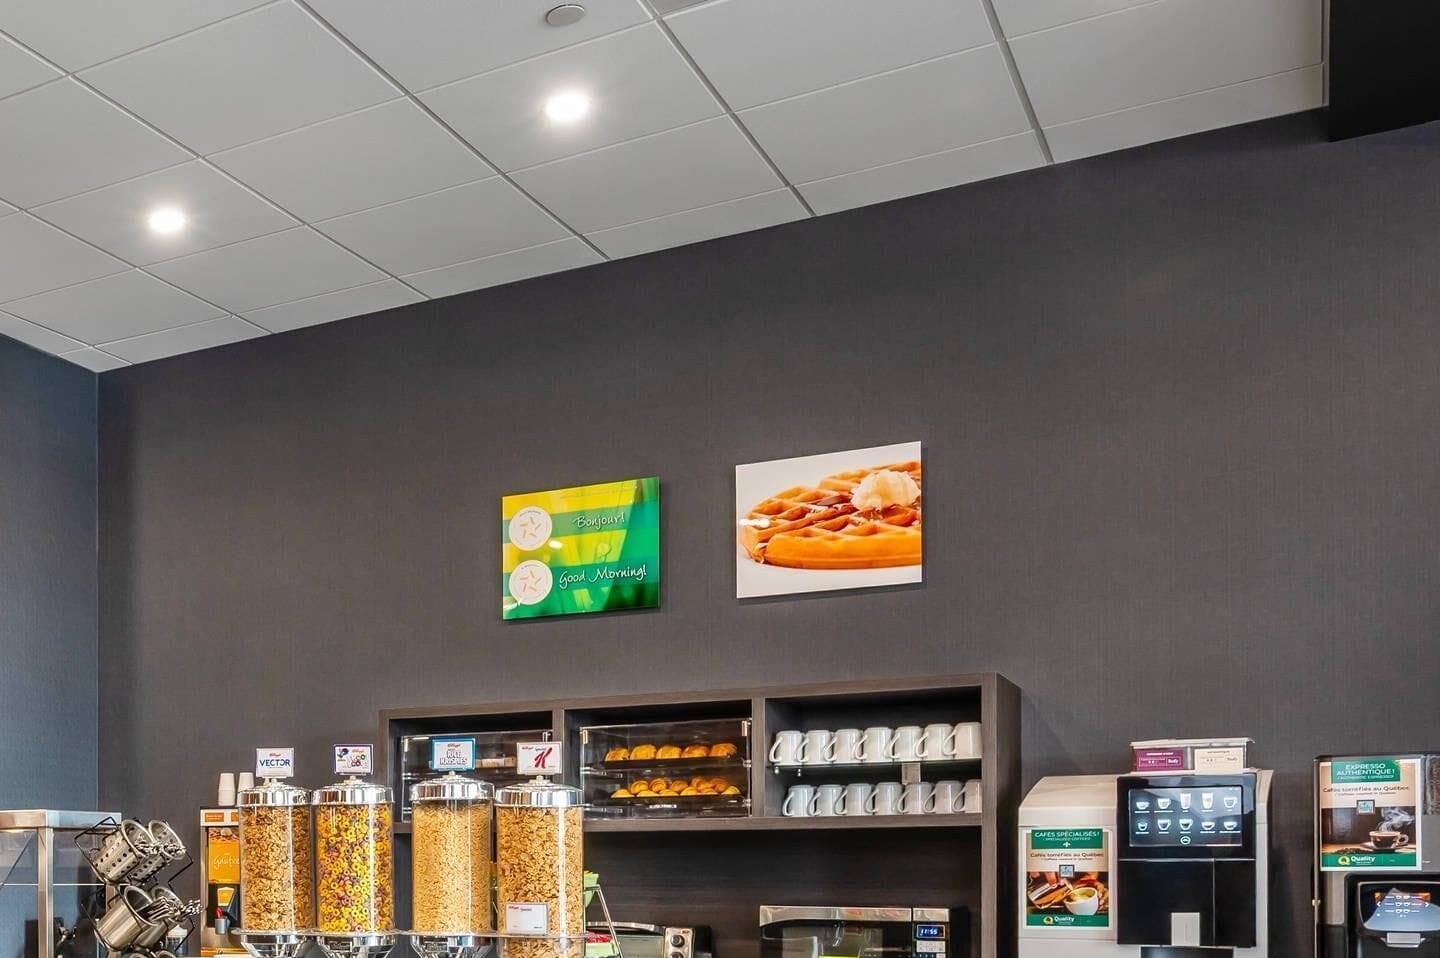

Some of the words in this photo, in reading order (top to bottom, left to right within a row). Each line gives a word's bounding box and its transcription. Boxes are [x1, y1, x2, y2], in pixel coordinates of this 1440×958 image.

[577, 511, 625, 530] Bonjour!
[559, 570, 586, 589] Good
[589, 564, 647, 582] Morning!
[259, 759, 291, 767] VECTOR
[534, 747, 553, 769] K
[1350, 855, 1376, 863] Quality
